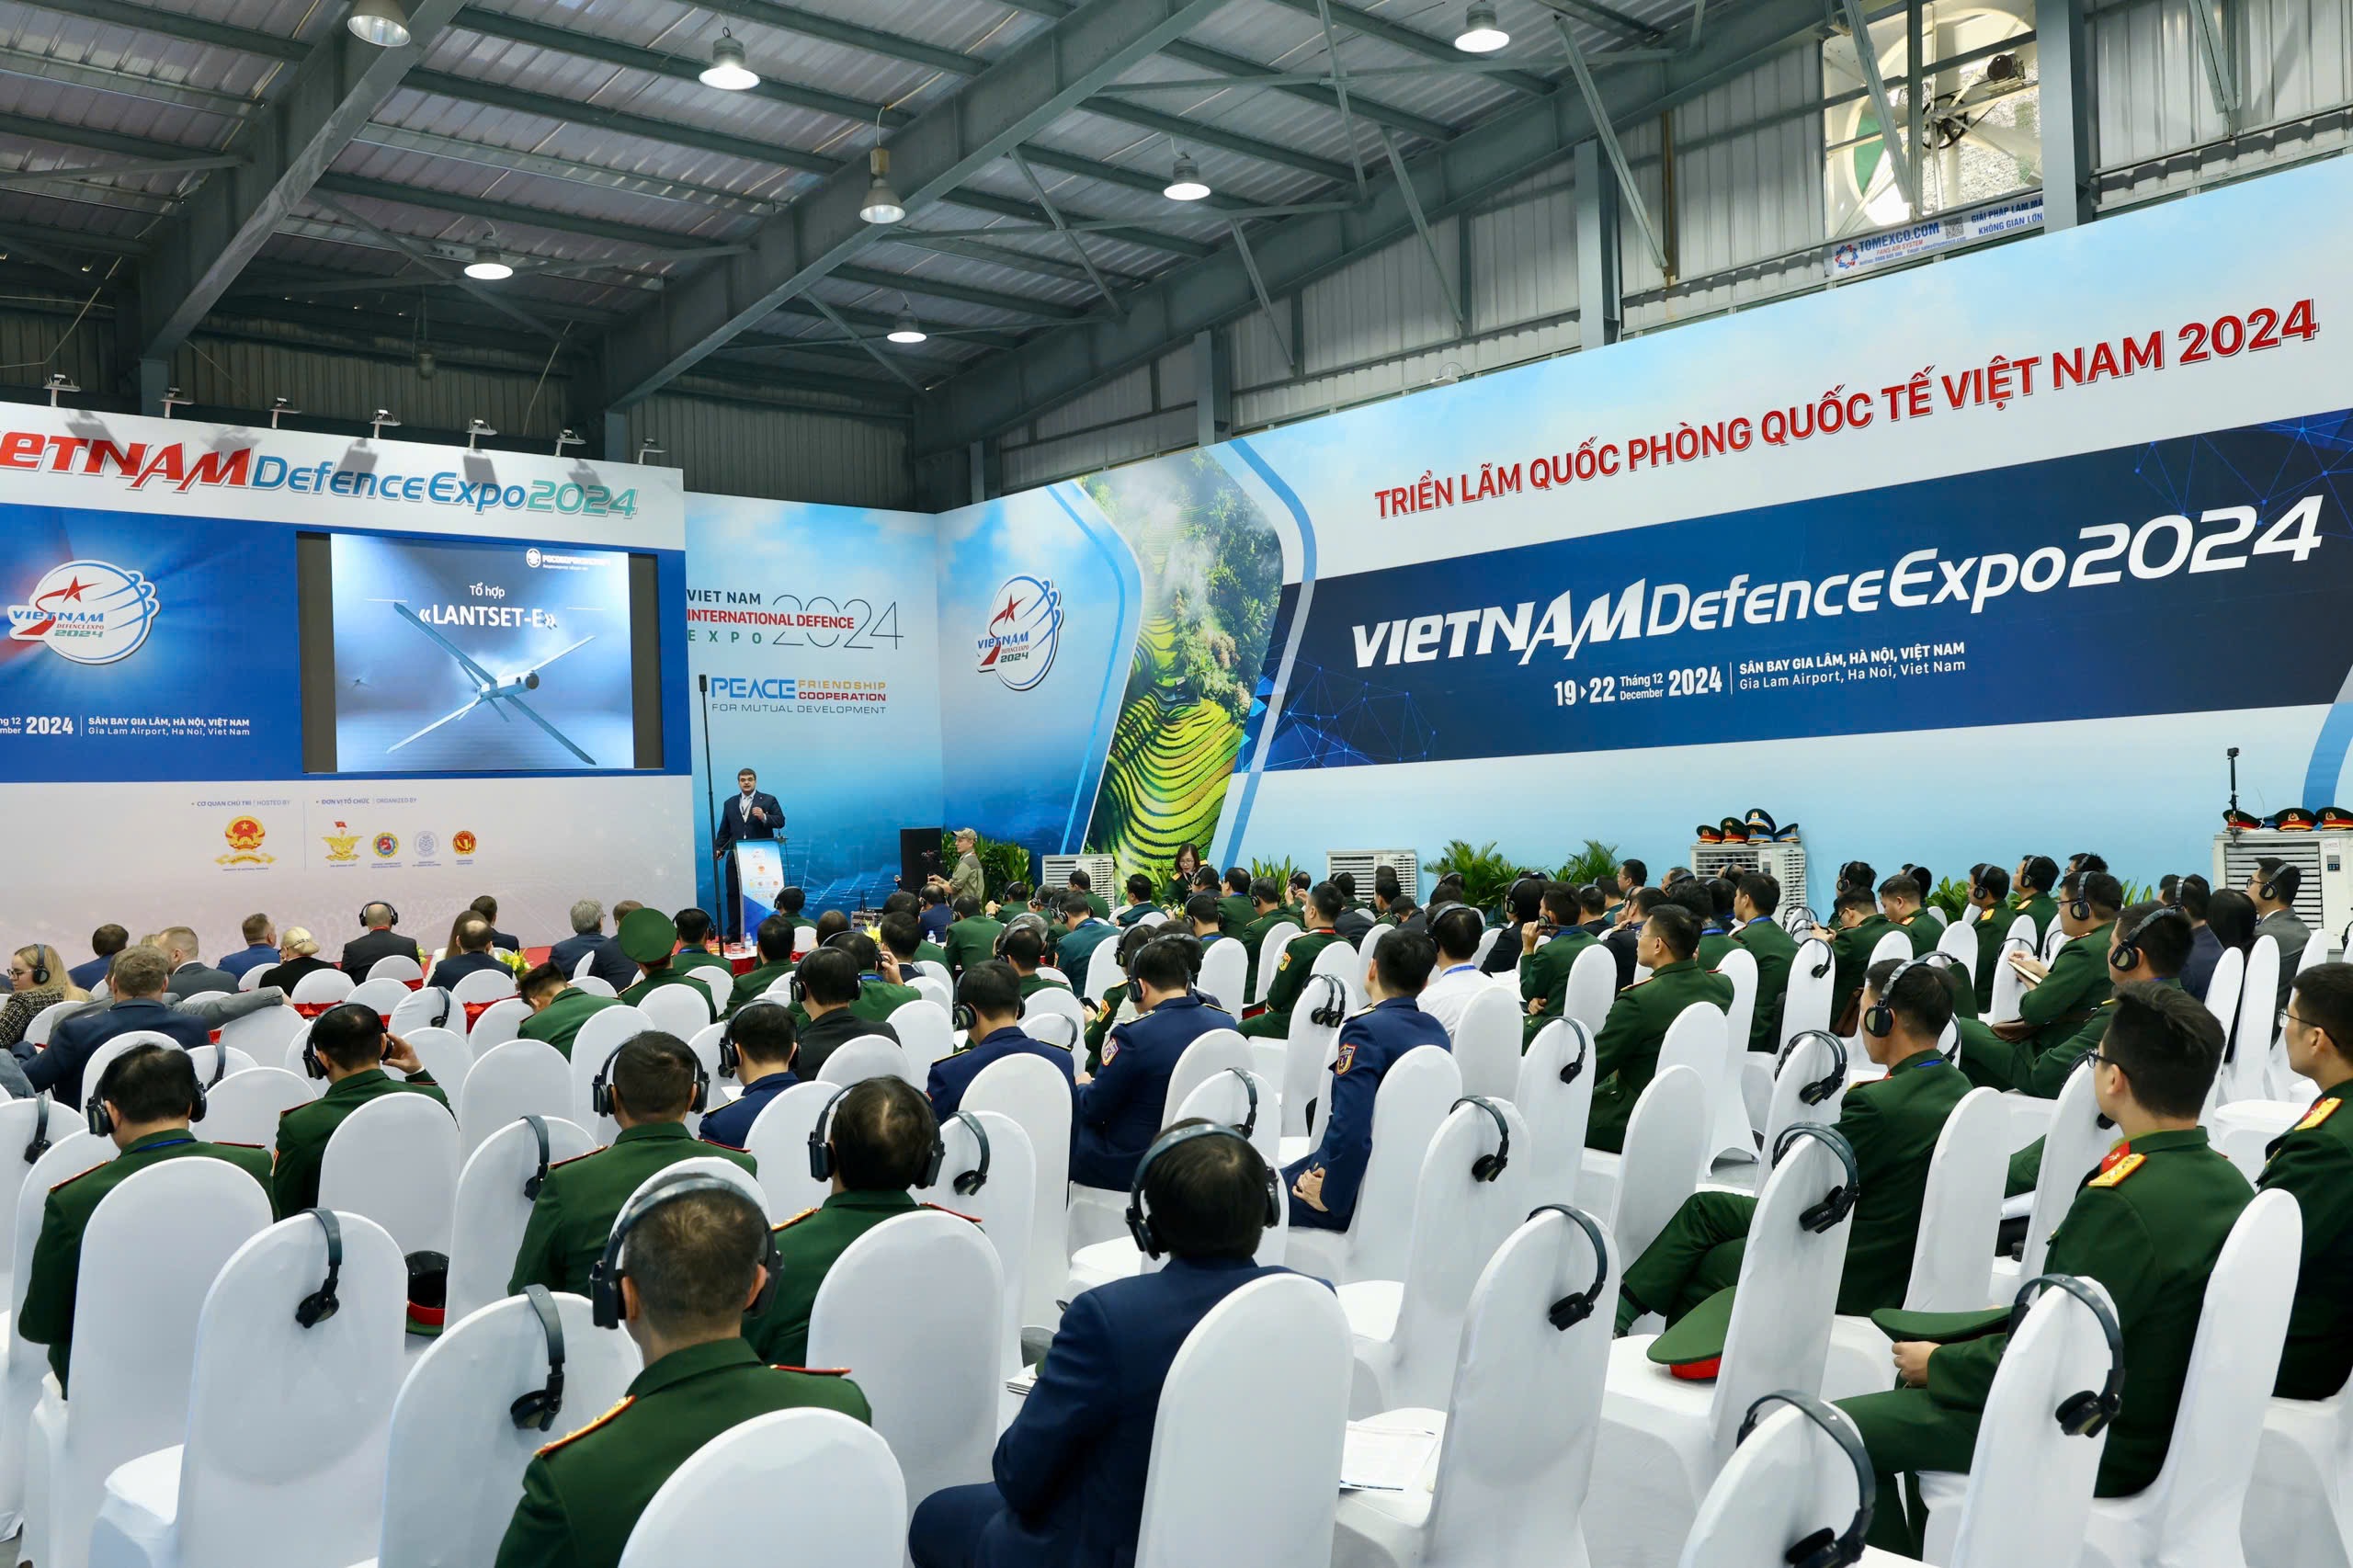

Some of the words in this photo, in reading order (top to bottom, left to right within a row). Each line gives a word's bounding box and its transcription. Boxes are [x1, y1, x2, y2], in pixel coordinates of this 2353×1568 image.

[2006, 217, 2025, 229] GIAN
[1859, 222, 1939, 252] TOMEXCO.COM
[1374, 469, 1455, 519] TRIỂN
[1461, 461, 1523, 503] LÃM
[1529, 436, 1621, 491] QUỐC
[1628, 417, 1751, 472] PHÒNG
[1760, 383, 1874, 447] QUỐC
[1881, 365, 1936, 423] TẾ
[1940, 355, 2041, 411] VIỆT
[2052, 330, 2165, 391] NAM
[2177, 298, 2319, 366] 2024
[469, 583, 483, 597] Tổ
[485, 585, 506, 598] hợp
[687, 589, 722, 604] VIET
[726, 591, 761, 605] NAM
[687, 608, 794, 627] INTERNATIONAL
[796, 614, 855, 630] DEFENCE
[772, 595, 904, 650] 2024
[54, 630, 104, 638] 2024
[1000, 652, 1029, 664] 2024
[1739, 658, 1766, 676] SÂN
[1767, 658, 1790, 673] BAY
[1792, 656, 1815, 671] GIA
[1816, 652, 1847, 670] LÂM,
[1849, 648, 1869, 665] HÀ
[1870, 647, 1898, 666] NỘI,
[1900, 643, 1930, 662] VIỆT
[1933, 642, 1965, 656] NAM
[1620, 674, 1651, 689] Tháng
[1651, 672, 1665, 686] 12
[1668, 666, 1723, 698] 2024
[1739, 676, 1760, 690] Gia
[1763, 675, 1790, 688] Lam
[1792, 669, 1845, 687] Airport,
[1847, 667, 1866, 681] Ha
[1869, 665, 1896, 681] Noi,
[1900, 661, 1930, 676] Viet
[1933, 658, 1966, 673] Nam
[710, 676, 796, 699] PEACE
[798, 679, 886, 690] FRIENDSHIP
[798, 691, 886, 702] COOPERATION
[1620, 687, 1665, 701] December
[711, 703, 737, 712] FOR
[741, 704, 793, 713] MUTUAL
[797, 705, 886, 714] DEVELOPMENT
[26, 716, 74, 734] 2024
[88, 717, 108, 726] SÂN
[110, 717, 129, 726] BAY
[131, 717, 147, 726] GIA
[149, 717, 171, 727] LÂM,
[173, 716, 186, 726] HÀ
[188, 717, 206, 728] NỘI,
[208, 717, 228, 728] VIỆT
[88, 726, 105, 735] Gia
[108, 727, 128, 735] Lam
[131, 727, 169, 737] Airport,
[172, 727, 185, 735] Ha
[188, 727, 206, 737] Noi,
